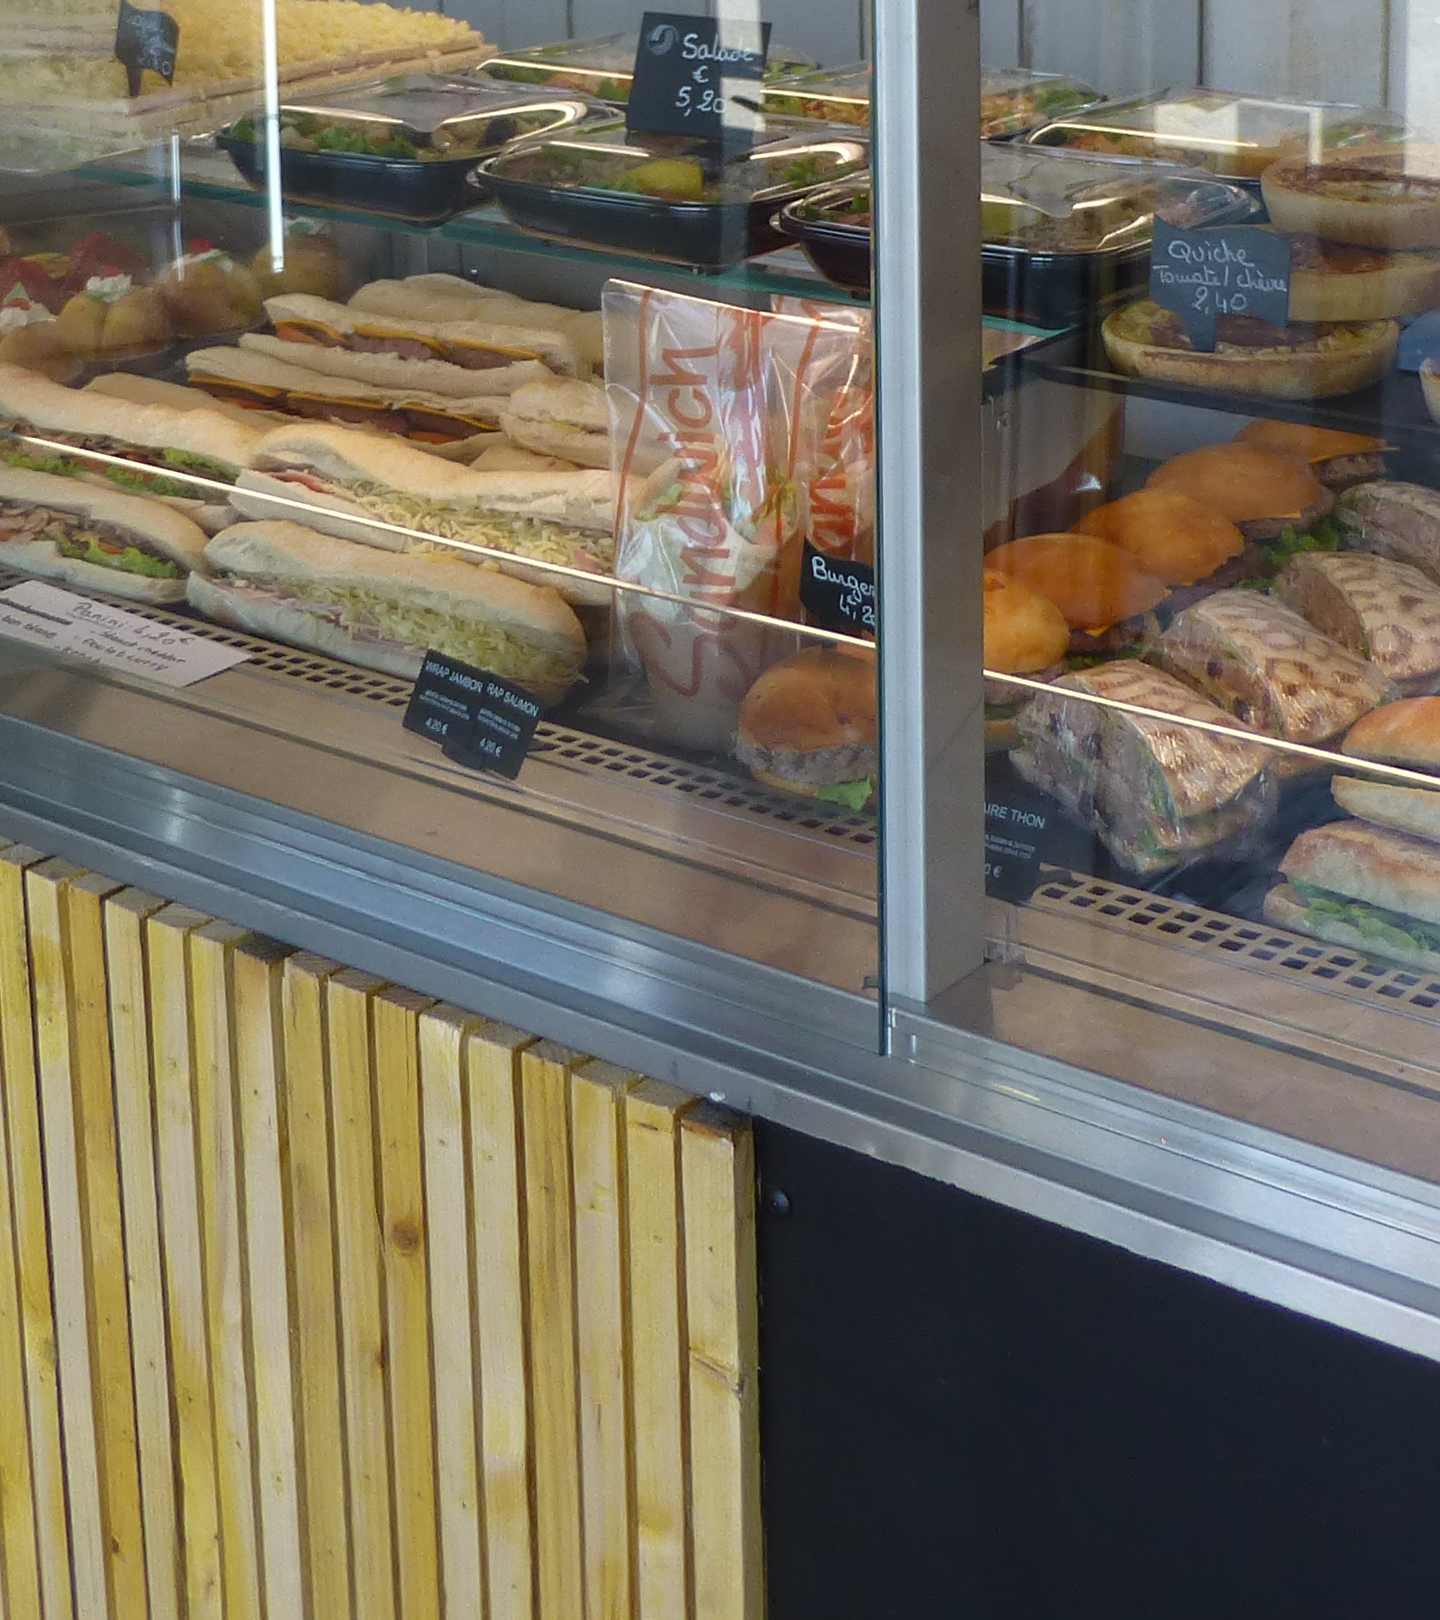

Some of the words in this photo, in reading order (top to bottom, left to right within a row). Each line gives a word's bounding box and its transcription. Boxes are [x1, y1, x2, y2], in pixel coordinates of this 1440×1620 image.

[681, 32, 755, 62] Salade
[675, 85, 727, 117] 5,20
[1167, 239, 1256, 268] Quiche
[1191, 286, 1248, 315] 2,40
[628, 344, 737, 698] Sandwich
[425, 659, 450, 679] WRAP
[486, 682, 505, 699] RAP
[503, 691, 540, 717] SAUMON
[1010, 808, 1046, 830] THON
